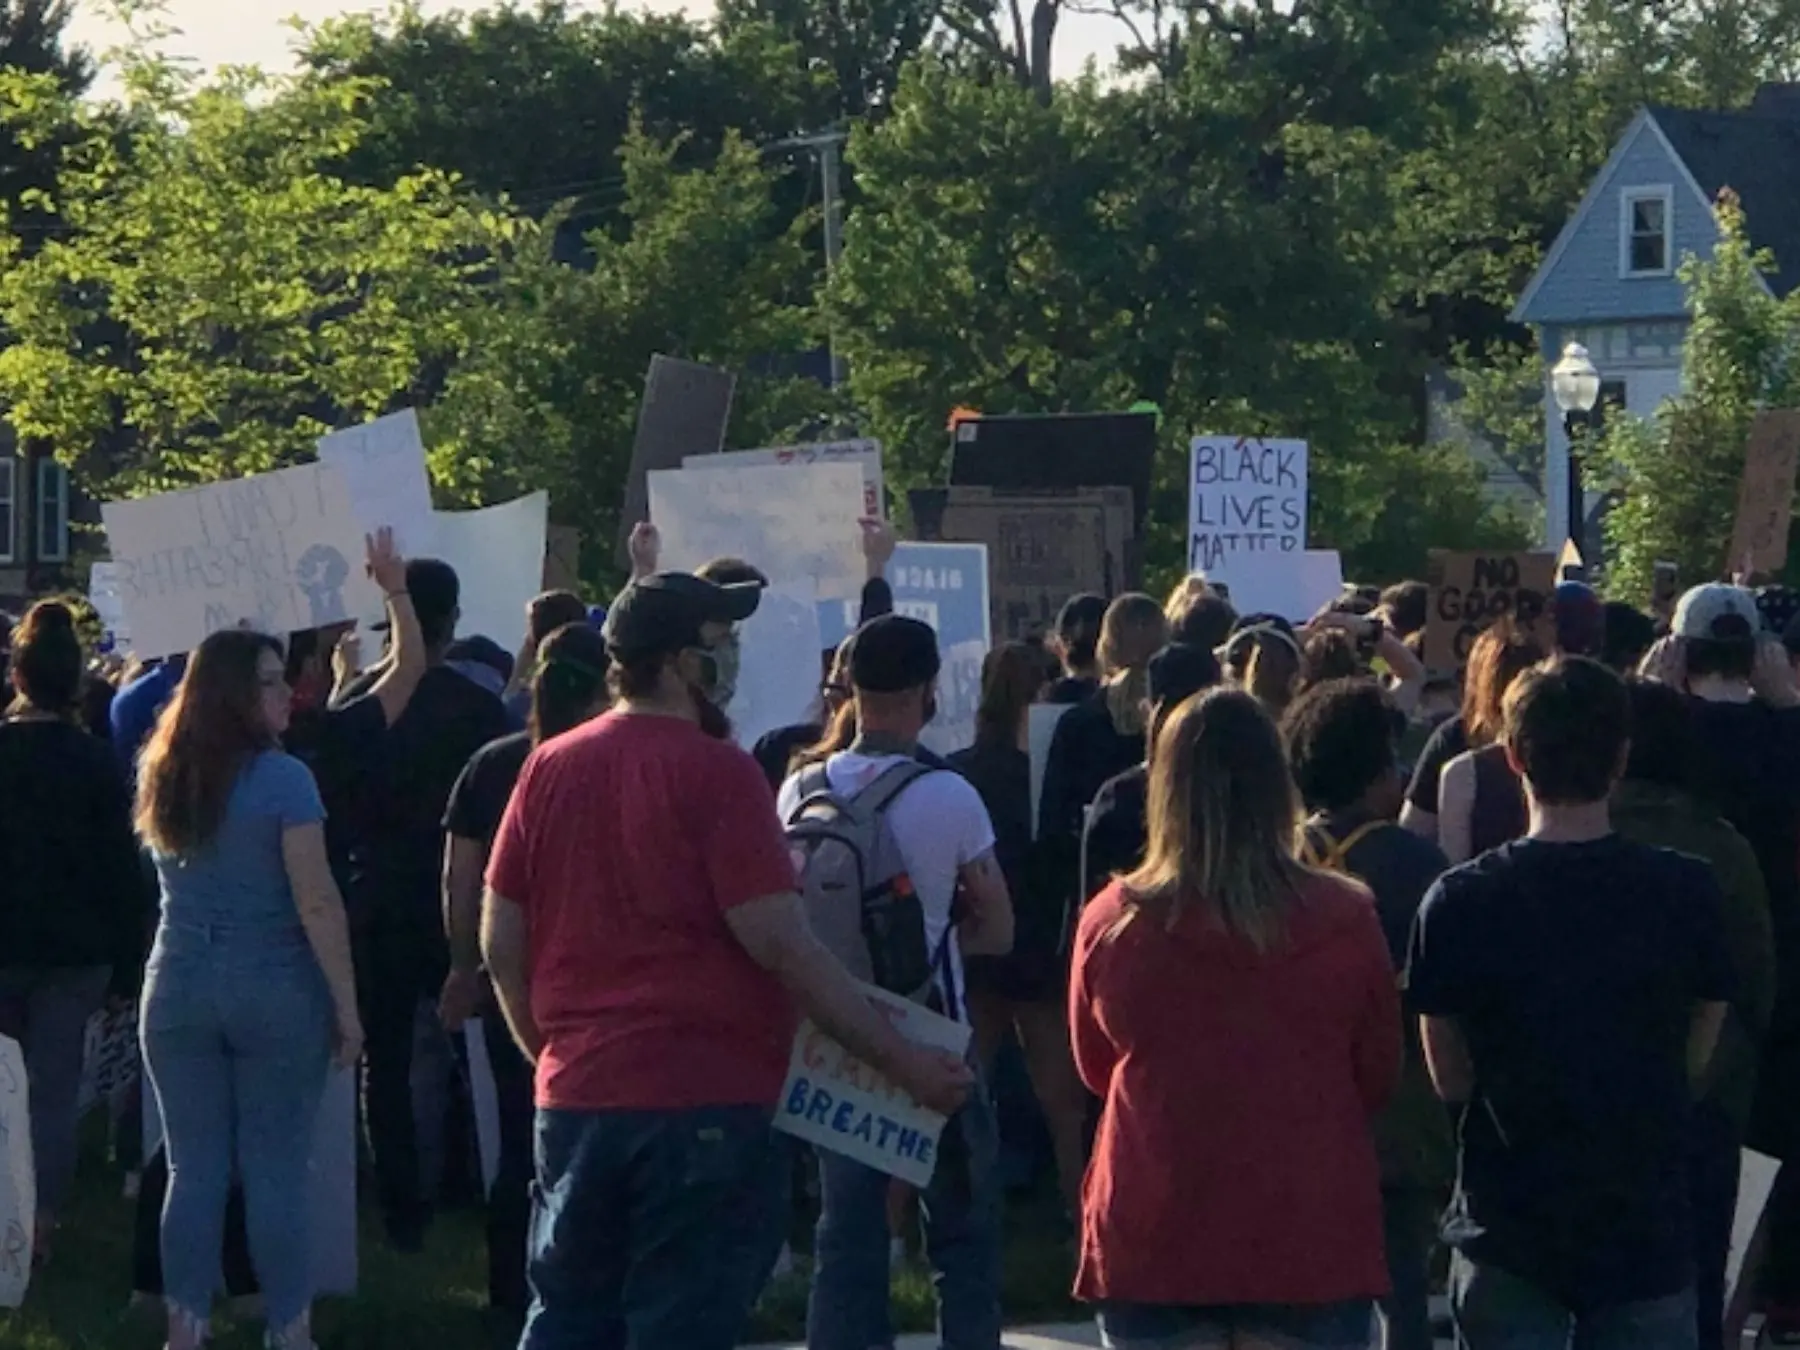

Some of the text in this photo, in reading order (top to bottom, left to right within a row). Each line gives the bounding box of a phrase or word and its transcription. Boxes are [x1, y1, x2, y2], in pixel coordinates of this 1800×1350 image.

[1196, 445, 1298, 488] BLACK
[1197, 493, 1301, 531] LIVES
[1473, 555, 1520, 588] NO
[786, 1075, 934, 1164] BREATHE
